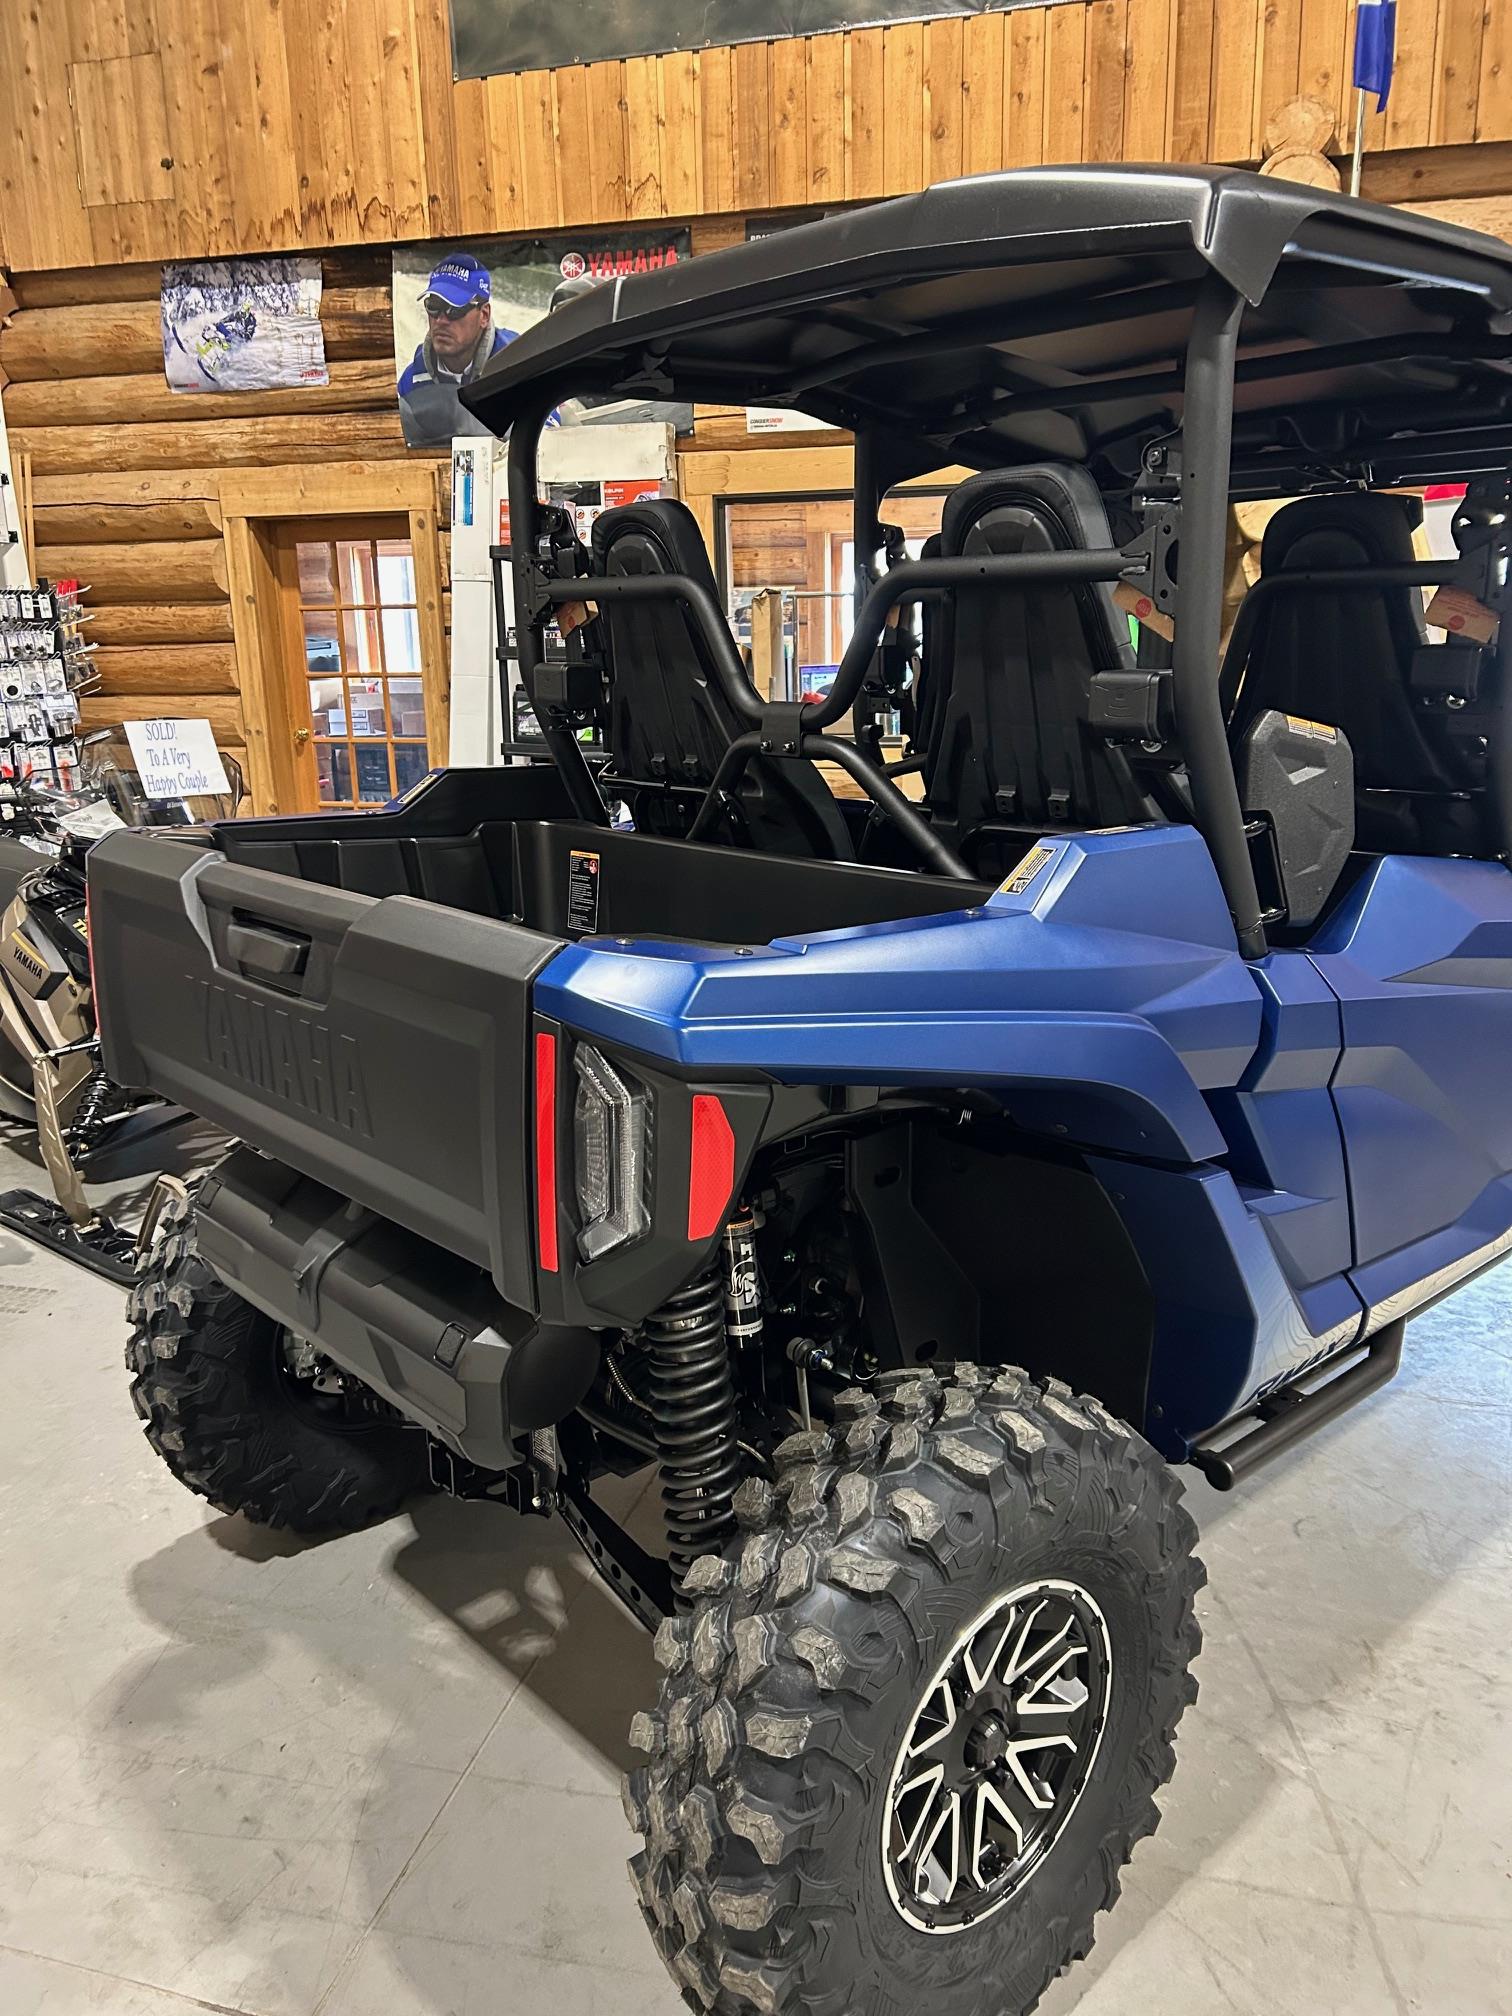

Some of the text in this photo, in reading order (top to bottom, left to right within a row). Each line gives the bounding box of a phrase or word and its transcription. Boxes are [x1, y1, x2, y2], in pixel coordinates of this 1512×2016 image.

[435, 264, 470, 279] YAMAHA
[586, 245, 678, 278] YAMAHA
[145, 722, 178, 741] SOLD!
[146, 747, 191, 769] To A Very
[145, 770, 209, 795] Happy Couple
[13, 946, 43, 980] YAMAHA
[184, 974, 376, 1139] YAMAHA
